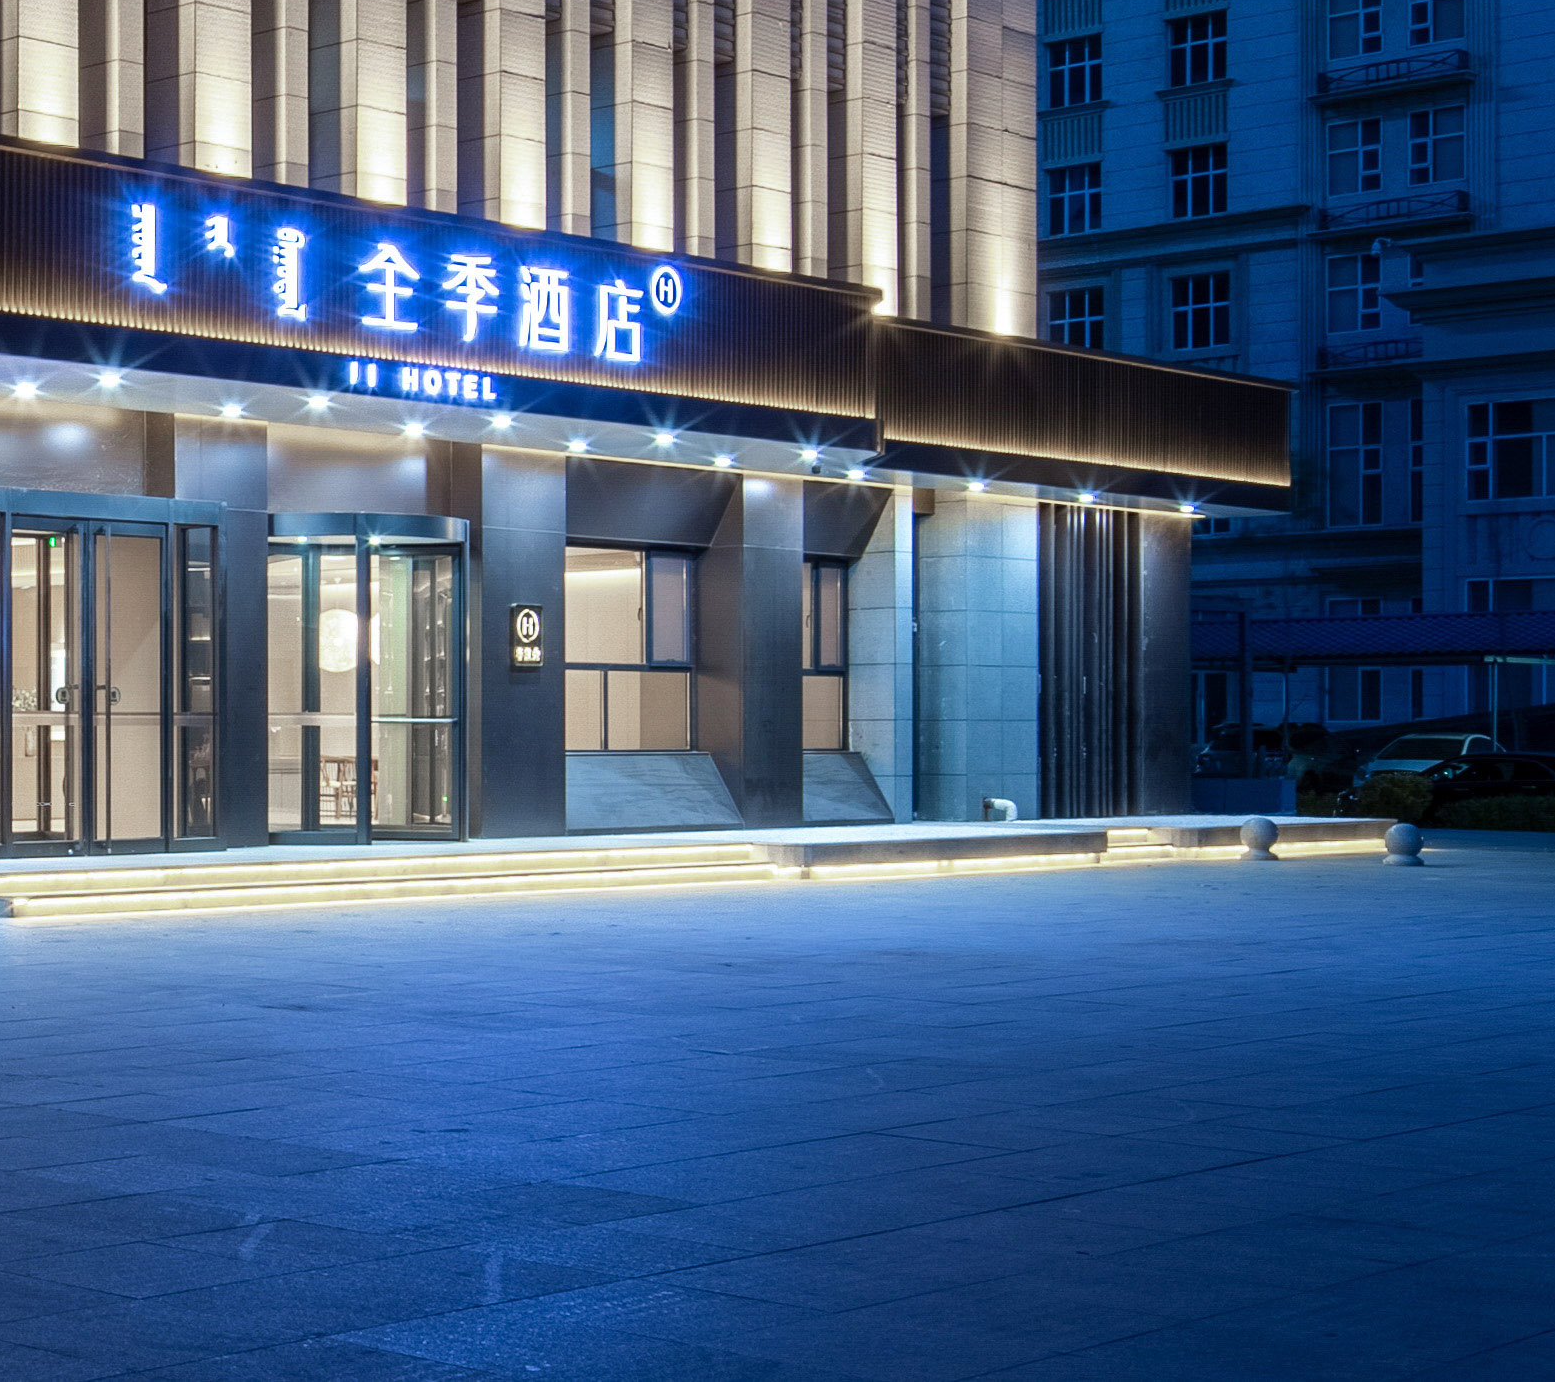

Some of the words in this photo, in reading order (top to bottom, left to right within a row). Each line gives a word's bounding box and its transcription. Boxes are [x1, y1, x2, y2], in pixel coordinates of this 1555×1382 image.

[357, 241, 645, 363] 全季酒店
[401, 366, 497, 401] HOTEL
